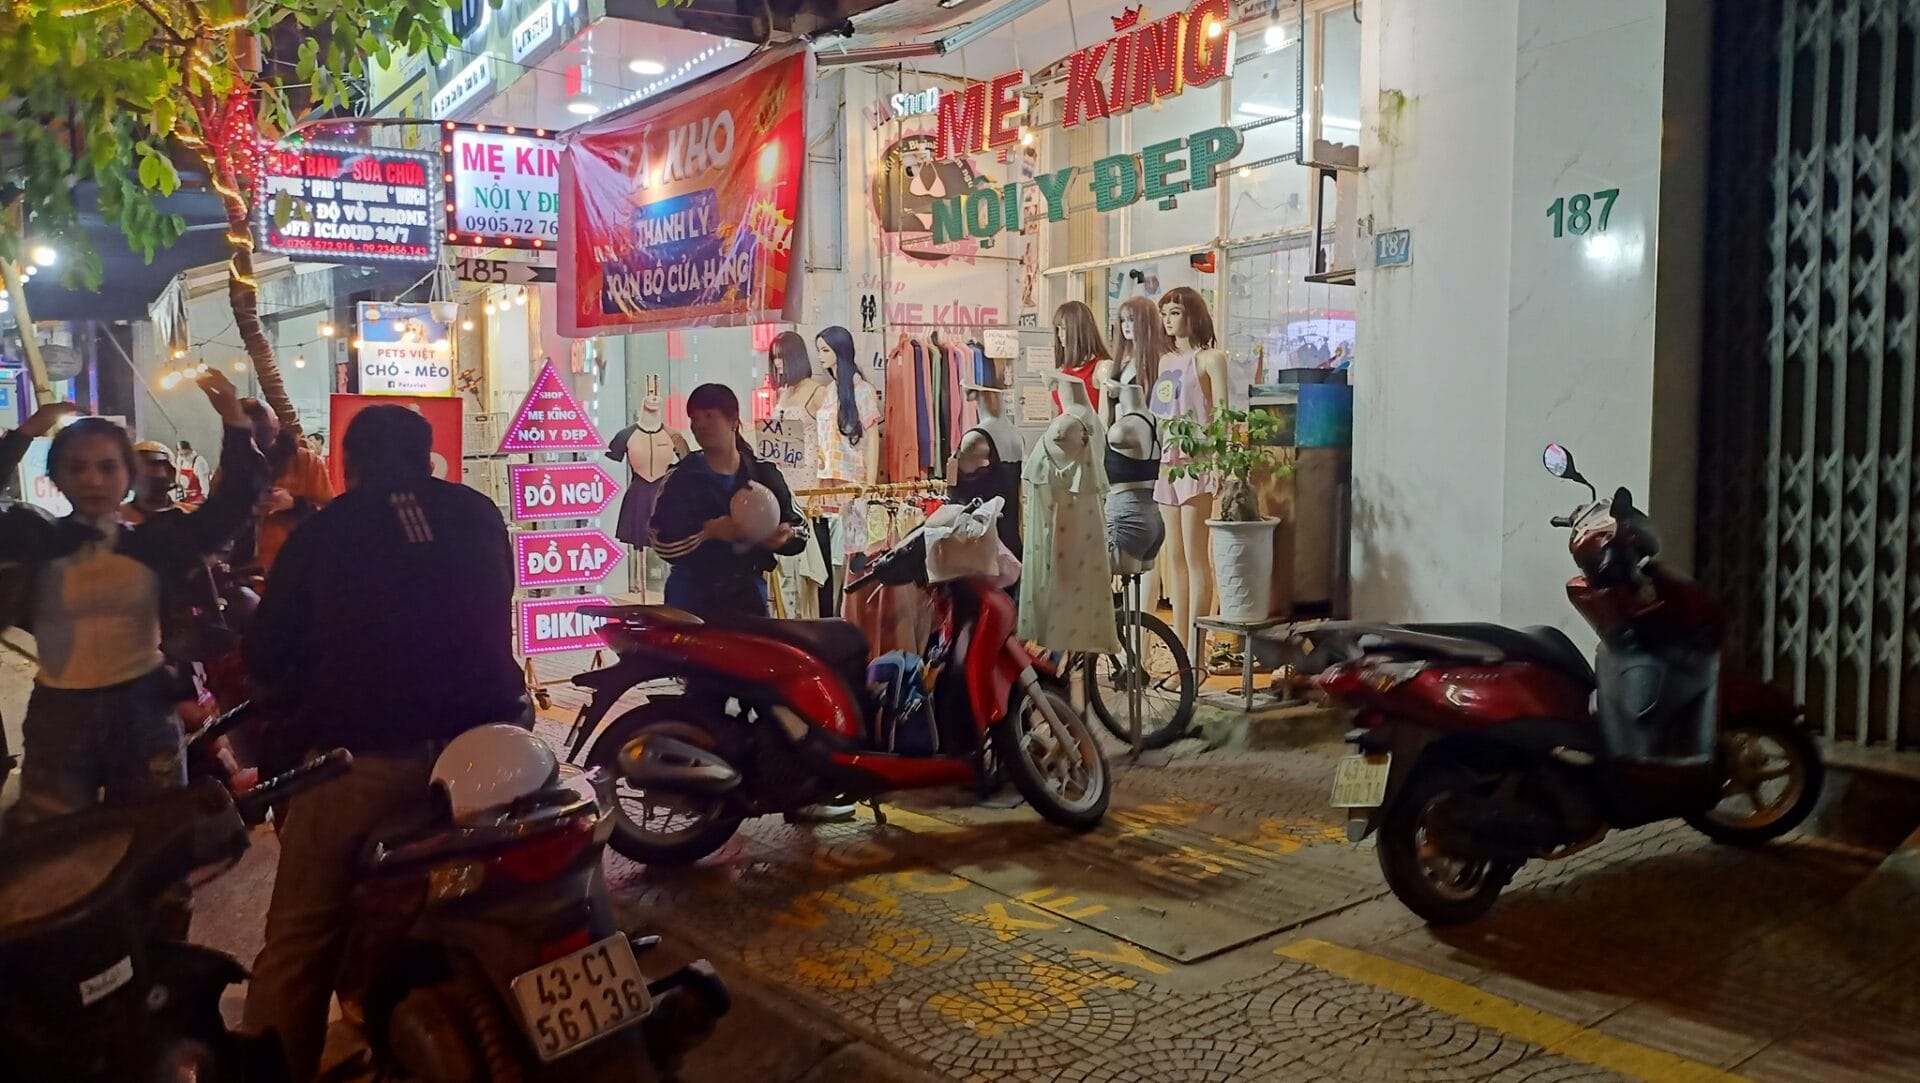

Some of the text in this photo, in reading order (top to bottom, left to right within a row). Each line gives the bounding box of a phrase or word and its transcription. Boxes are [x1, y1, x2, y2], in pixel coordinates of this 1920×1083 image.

[934, 71, 1026, 164] MẸ
[462, 142, 505, 180] MẸ
[663, 110, 735, 184] KHO
[474, 182, 511, 213] NỘI
[517, 190, 532, 211] Y
[932, 127, 1244, 249] NỘI Y ĐẸP
[465, 215, 533, 234] 0905.72
[689, 196, 710, 238] LÝ
[1546, 189, 1620, 238] 187
[314, 222, 375, 241] ICLOUD
[1378, 231, 1410, 258] 187
[456, 257, 508, 283] 185
[644, 258, 665, 302] BỘ
[667, 253, 699, 294] CỬA
[365, 361, 400, 376] CHÓ
[415, 362, 450, 377] MÈO
[377, 347, 436, 360] PETS VIỆT
[540, 391, 564, 399] SHOP
[527, 410, 545, 423] MẸ
[518, 426, 588, 444] NỘI Y ĐẸP
[524, 473, 604, 507] ĐỒ NGỦ
[527, 540, 608, 576] ĐỒ TẬP
